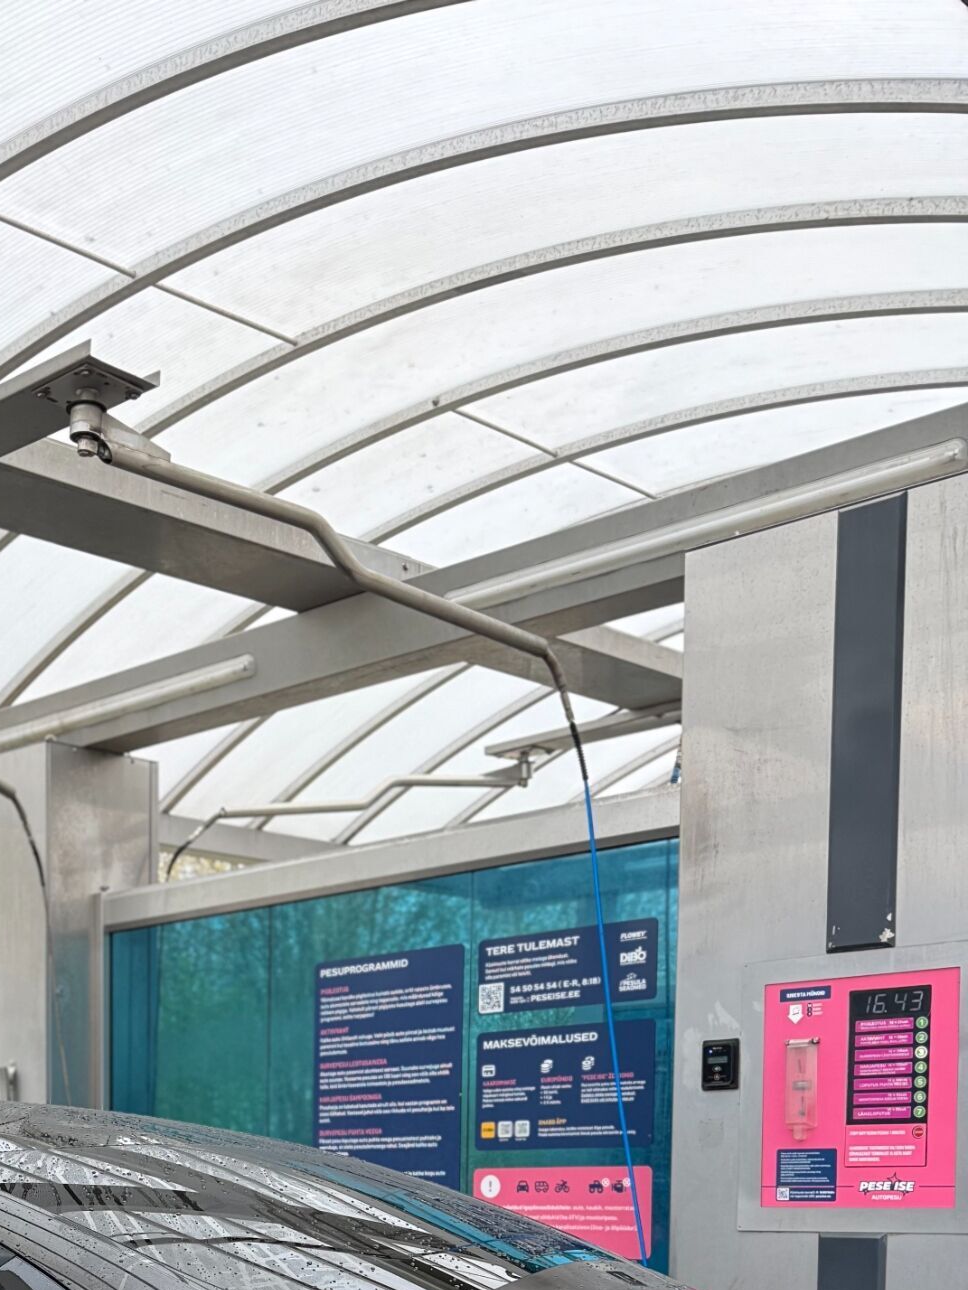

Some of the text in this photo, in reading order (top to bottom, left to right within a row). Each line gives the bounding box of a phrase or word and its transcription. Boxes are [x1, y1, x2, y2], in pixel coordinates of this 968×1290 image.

[485, 935, 580, 956] TERE TULEMAST
[320, 958, 409, 978] PESUPROGRAMMID
[530, 990, 580, 1003] PESEISE.EE
[483, 1031, 599, 1050] MAKSEVÕIMALUSED
